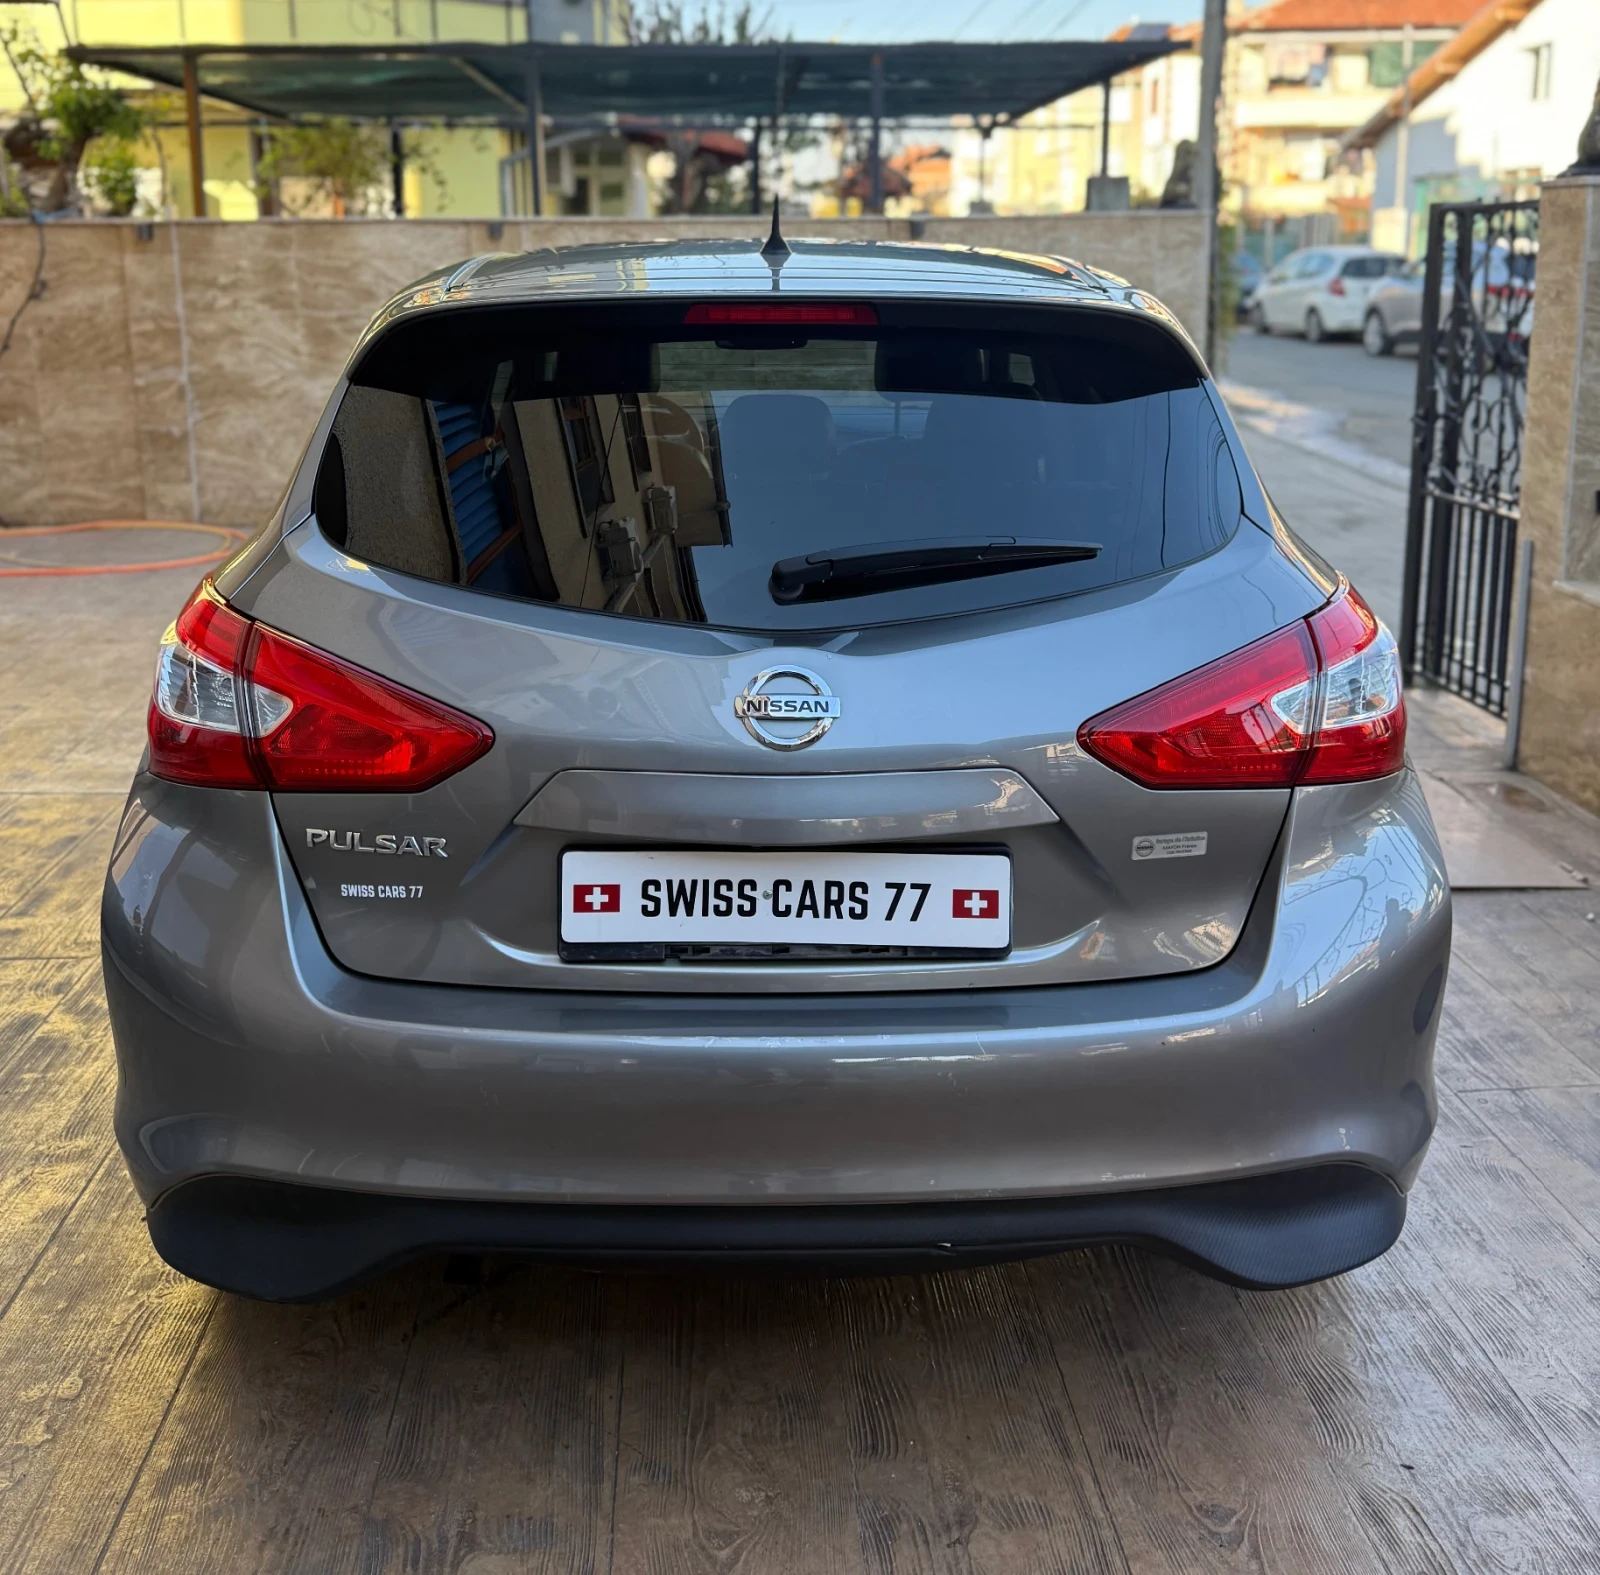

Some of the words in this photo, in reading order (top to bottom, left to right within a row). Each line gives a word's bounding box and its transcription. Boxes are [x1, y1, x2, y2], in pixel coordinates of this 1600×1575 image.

[746, 700, 829, 713] NISSAN
[305, 828, 448, 857] PULSAR
[340, 884, 375, 898] SWISS
[378, 885, 406, 898] CARS
[409, 885, 424, 899] 77
[640, 878, 757, 918] SWISS
[771, 878, 869, 921] CARS
[883, 882, 931, 923] 77
